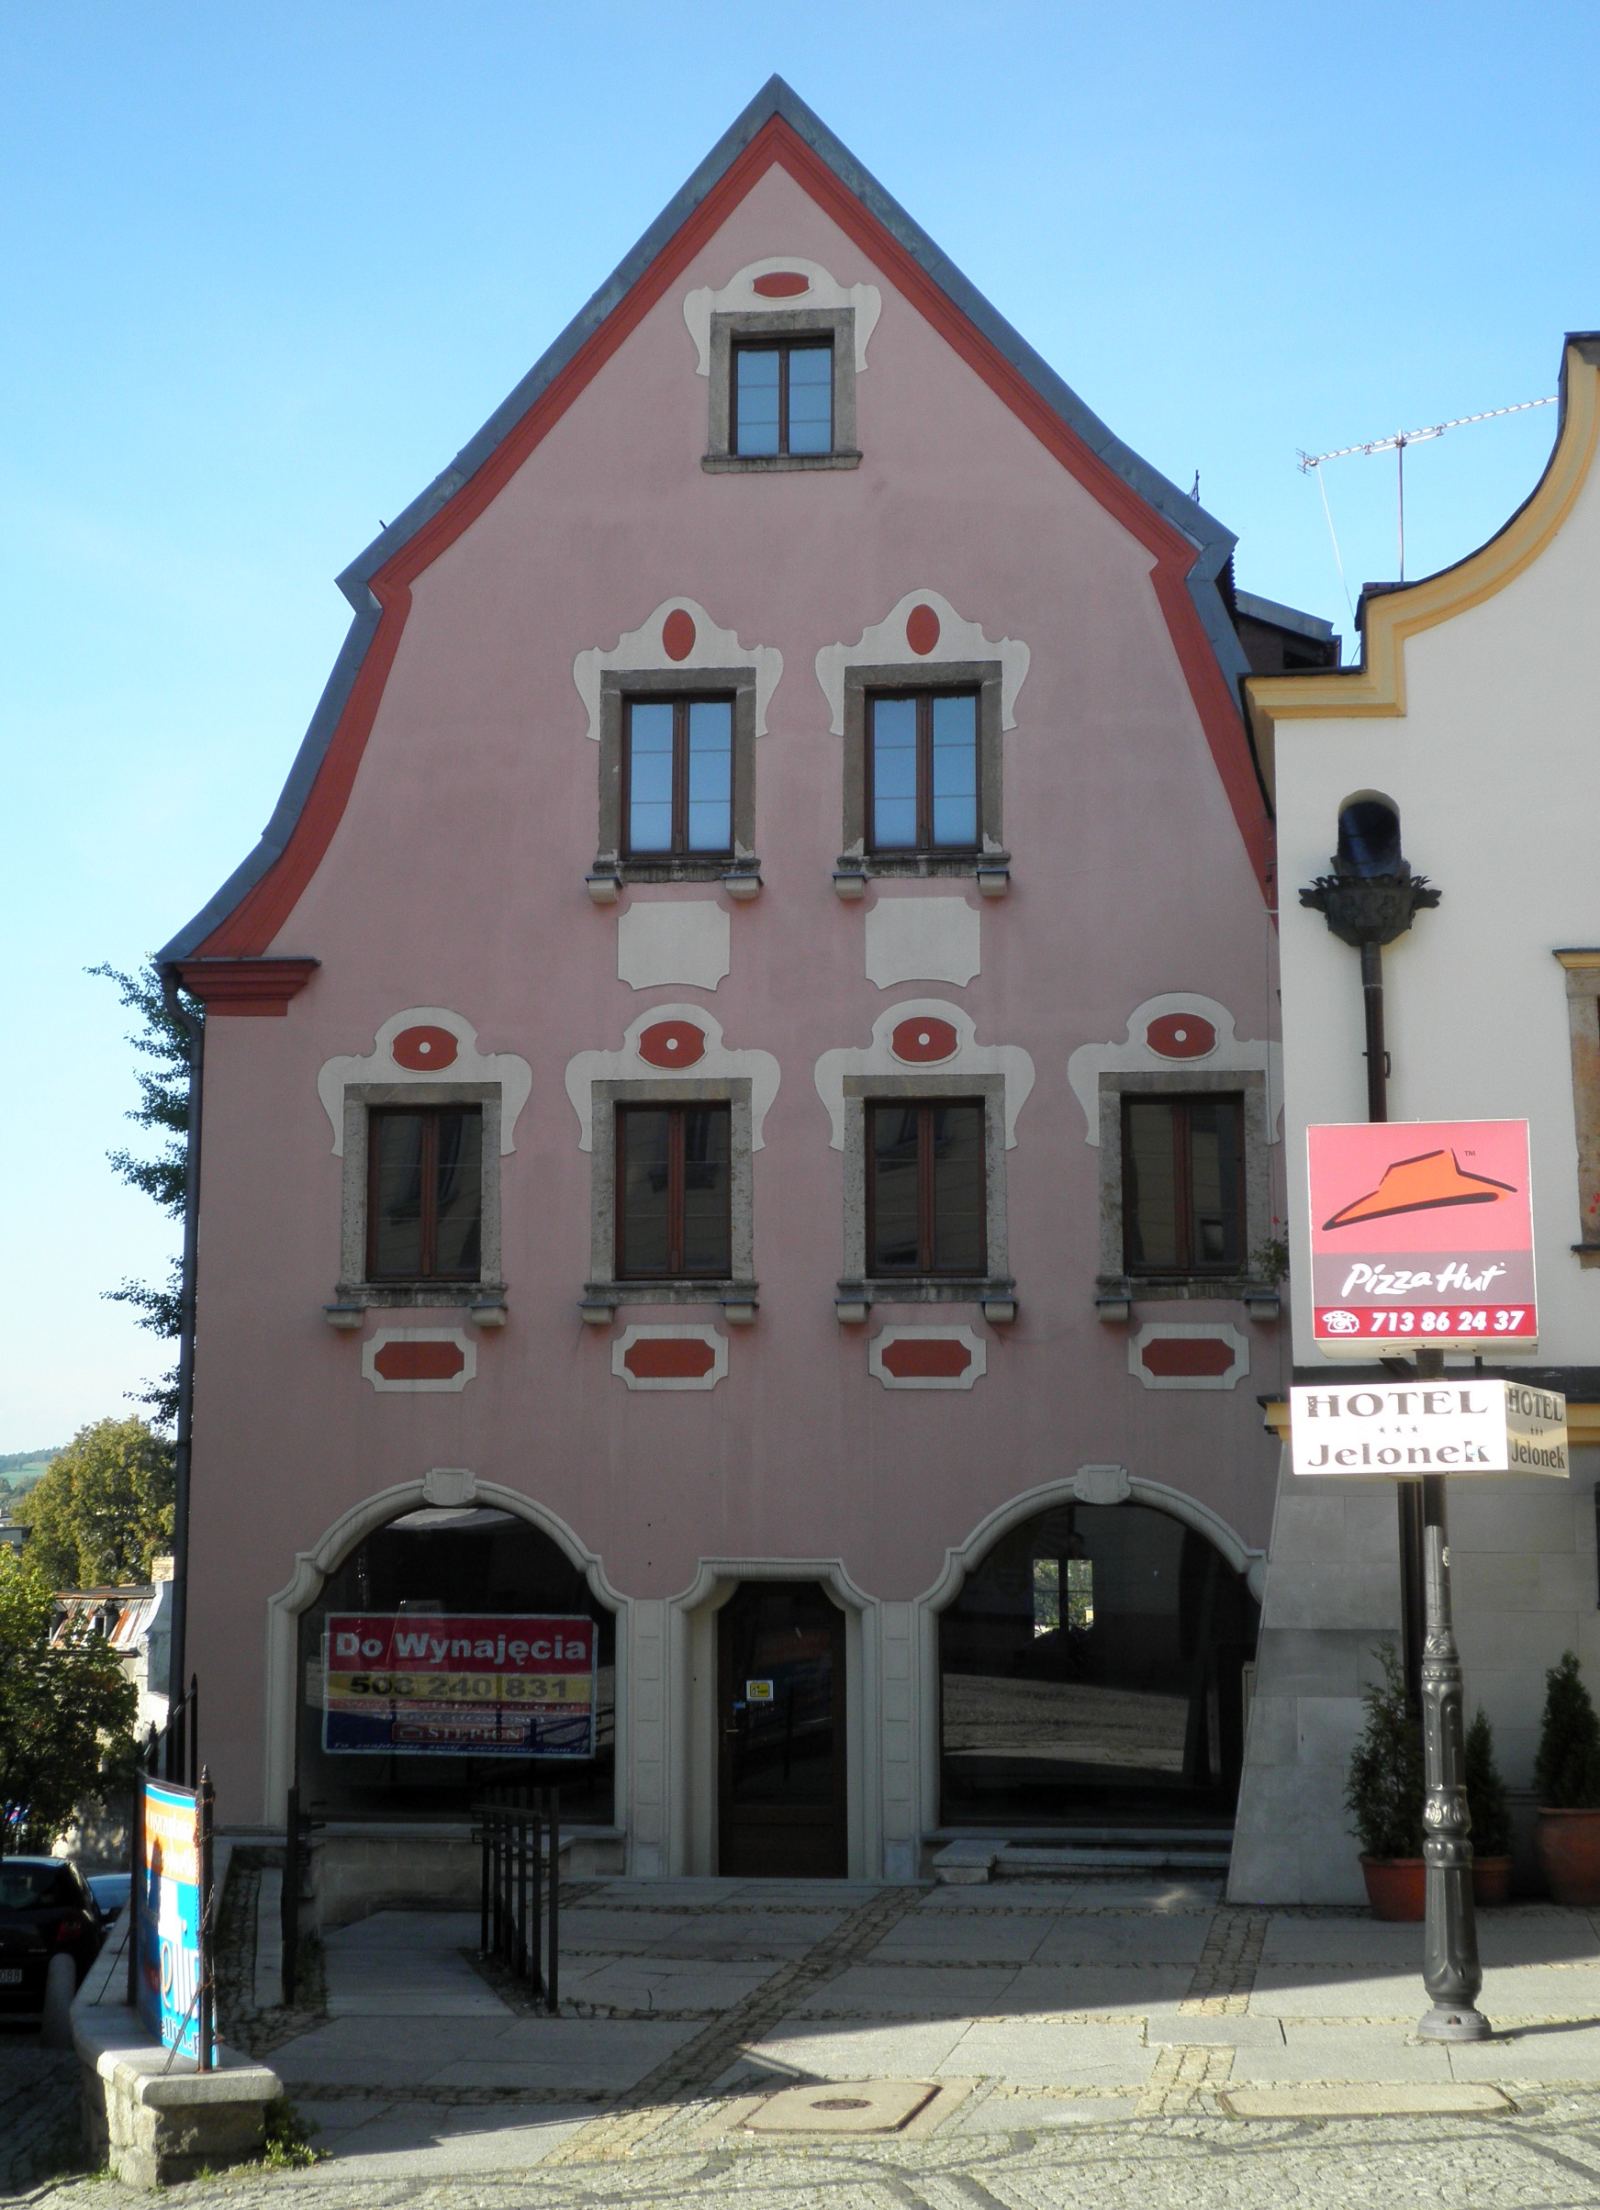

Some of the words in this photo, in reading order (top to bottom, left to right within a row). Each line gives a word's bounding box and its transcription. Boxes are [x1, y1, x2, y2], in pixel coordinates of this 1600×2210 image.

[1341, 1262, 1433, 1298] Pizza
[1435, 1261, 1507, 1293] Hut
[1370, 1311, 1415, 1332] 713
[1420, 1311, 1450, 1332] 86
[1457, 1310, 1487, 1331] 24
[1493, 1310, 1525, 1331] 37
[1306, 1390, 1488, 1418] HOTEL
[1508, 1387, 1563, 1422] HOTEL
[1307, 1440, 1491, 1467] Jelonek
[1511, 1438, 1565, 1469] Jelonek
[336, 1632, 383, 1657] Do
[395, 1632, 587, 1664] Wynajęcia
[428, 1678, 493, 1698] 240
[505, 1679, 567, 1699] 831
